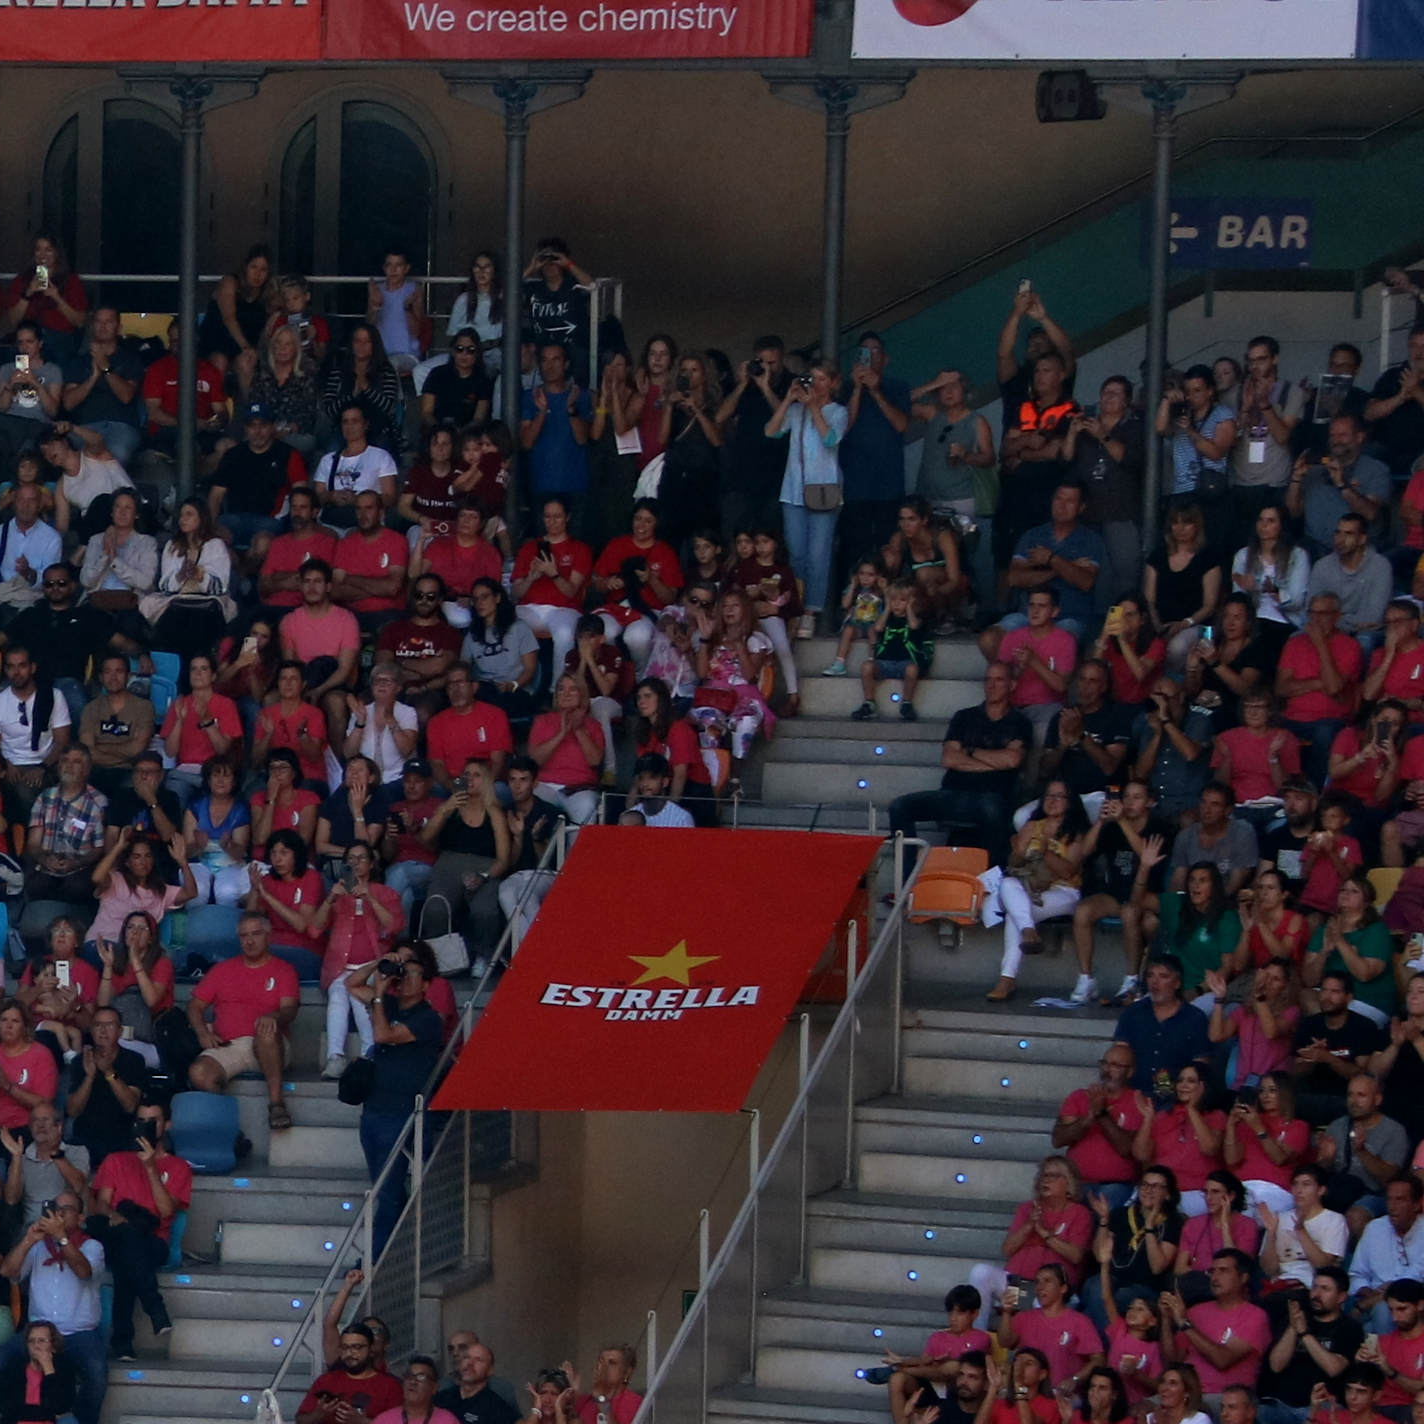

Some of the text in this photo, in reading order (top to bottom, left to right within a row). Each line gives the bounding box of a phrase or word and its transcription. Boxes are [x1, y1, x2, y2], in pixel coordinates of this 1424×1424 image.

[404, 0, 738, 36] We create chemistry
[1216, 215, 1310, 249] BAR
[539, 981, 761, 1010] ESTRELLA
[603, 1009, 684, 1021] DAMM
